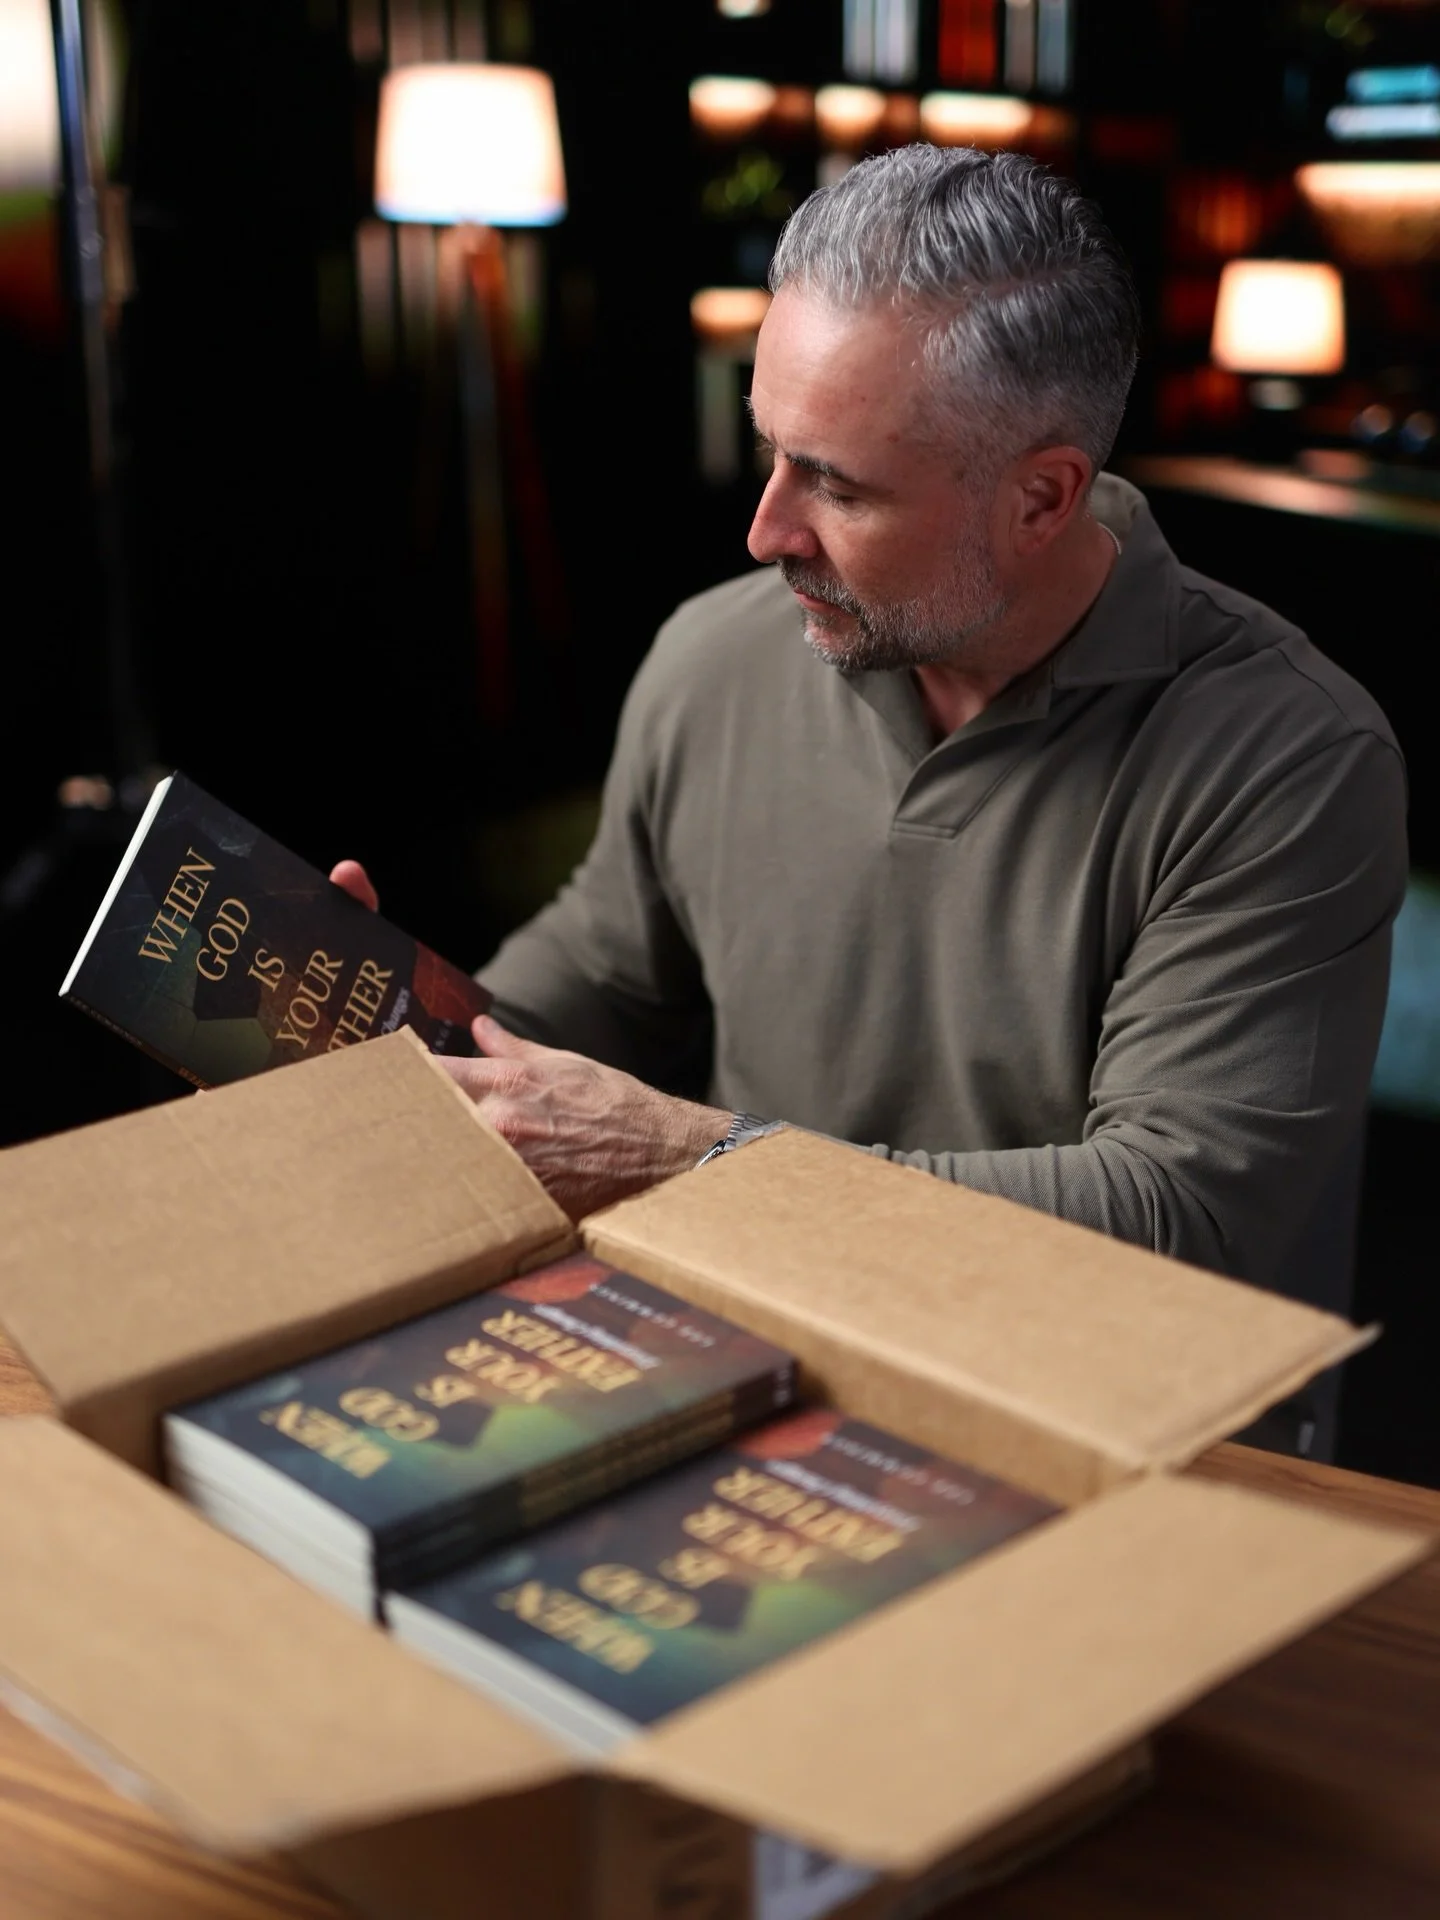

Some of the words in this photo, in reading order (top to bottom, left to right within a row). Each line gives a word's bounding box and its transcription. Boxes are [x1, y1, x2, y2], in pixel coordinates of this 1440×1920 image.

[138, 846, 217, 965] WHEN
[195, 897, 250, 982] GOD
[247, 948, 285, 993] IS
[275, 949, 344, 1050] YOUR
[327, 959, 394, 1053] THER
[445, 1337, 563, 1403] YOUR
